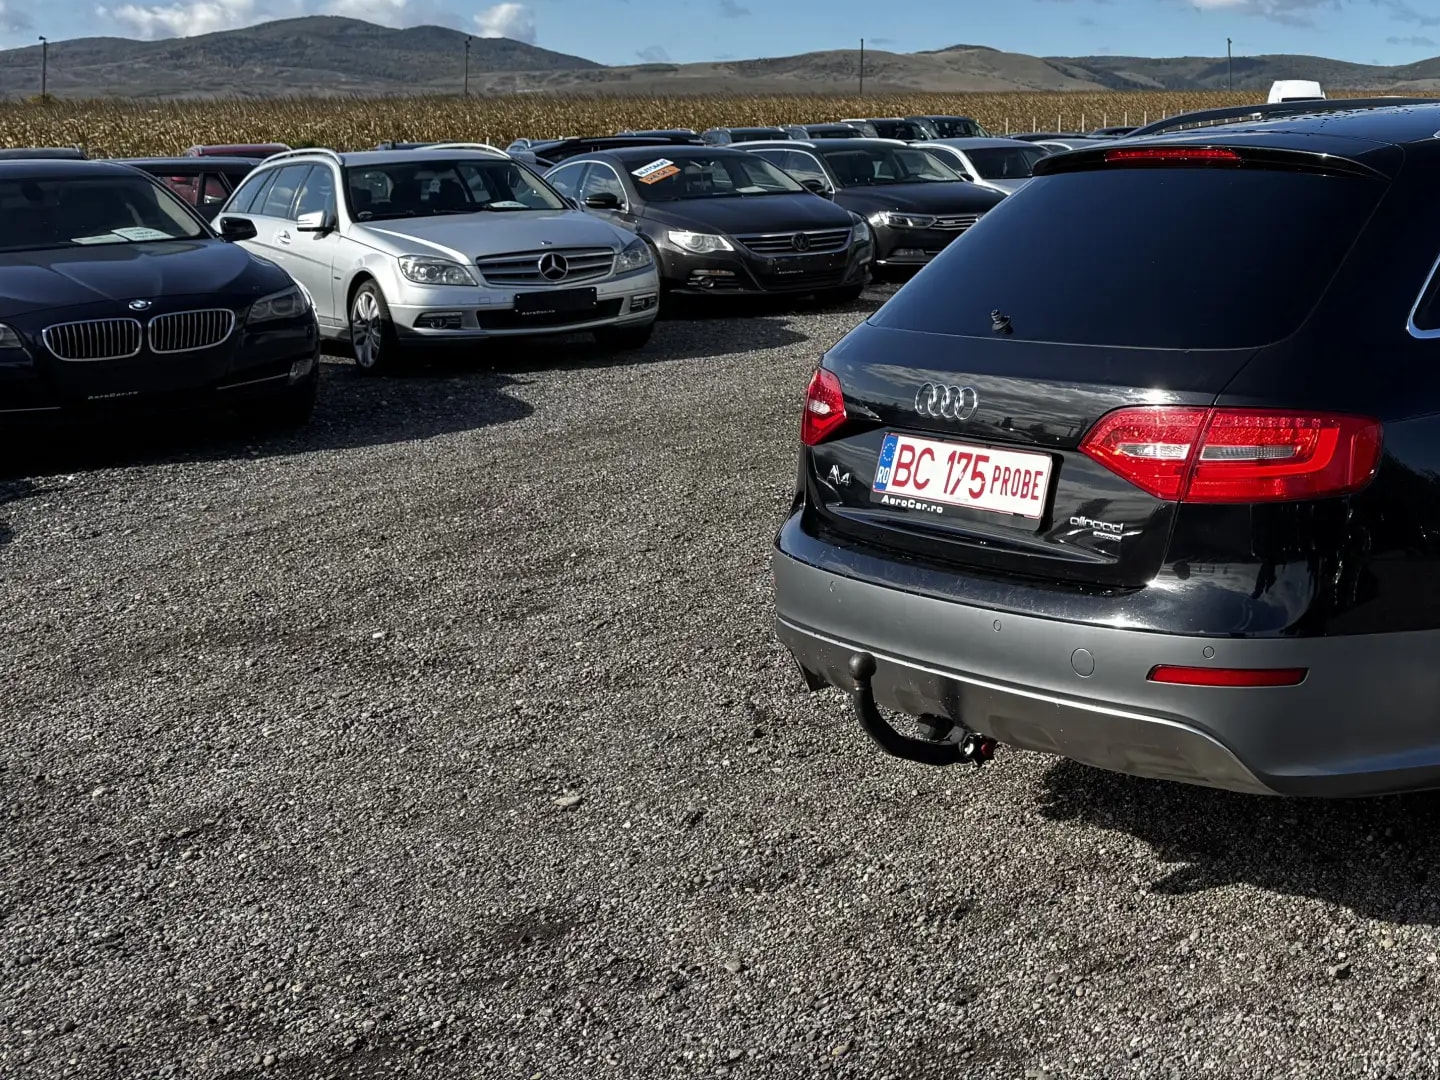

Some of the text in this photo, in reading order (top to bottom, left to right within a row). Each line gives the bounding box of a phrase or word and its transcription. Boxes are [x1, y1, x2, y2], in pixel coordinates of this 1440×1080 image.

[826, 464, 851, 486] A4
[875, 466, 890, 484] RO
[892, 444, 1044, 500] BC 175 PROBE
[881, 495, 944, 514] AeroCar.ro
[1069, 515, 1124, 534] allroad
